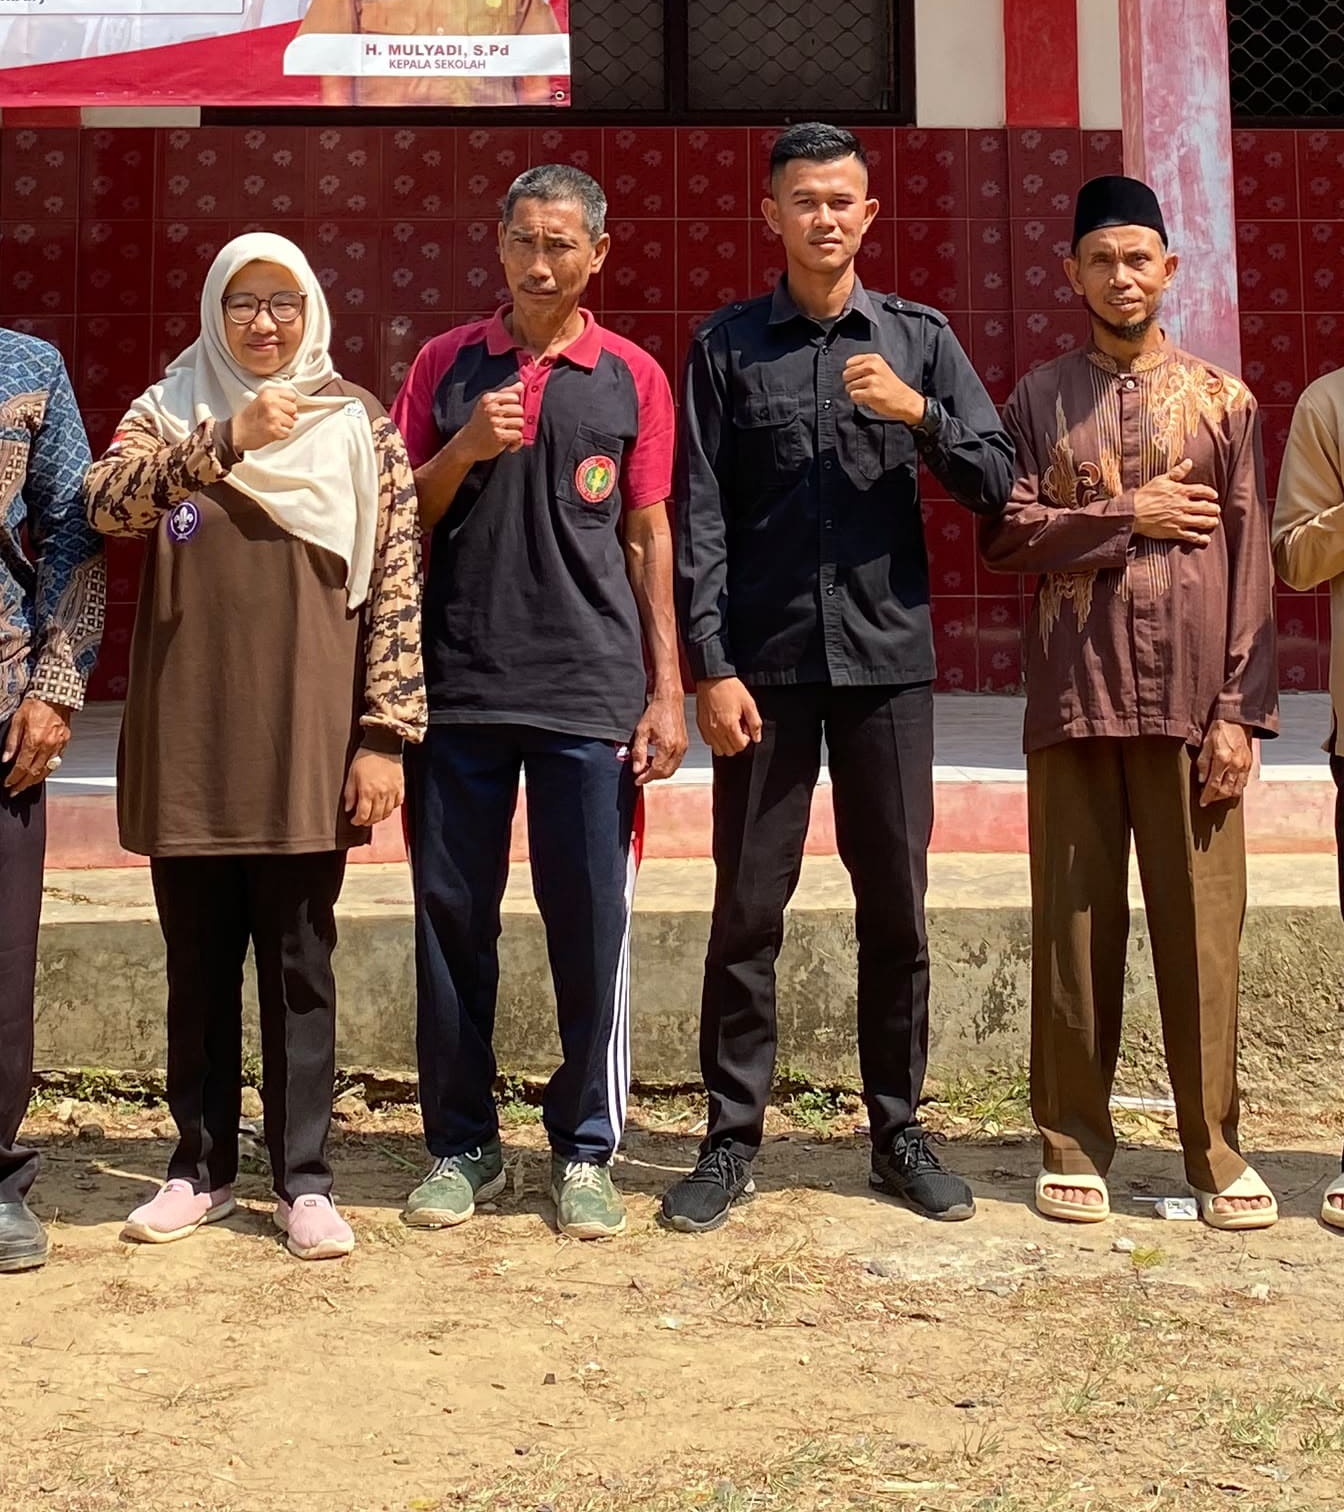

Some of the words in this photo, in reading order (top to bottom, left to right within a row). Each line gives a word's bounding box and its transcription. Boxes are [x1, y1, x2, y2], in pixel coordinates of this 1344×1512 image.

[365, 44, 382, 56] H.
[388, 44, 468, 58] MULYADI,
[473, 44, 509, 56] S.Pd
[389, 59, 432, 69] KEPALA
[434, 59, 486, 70] SEKOLAH
